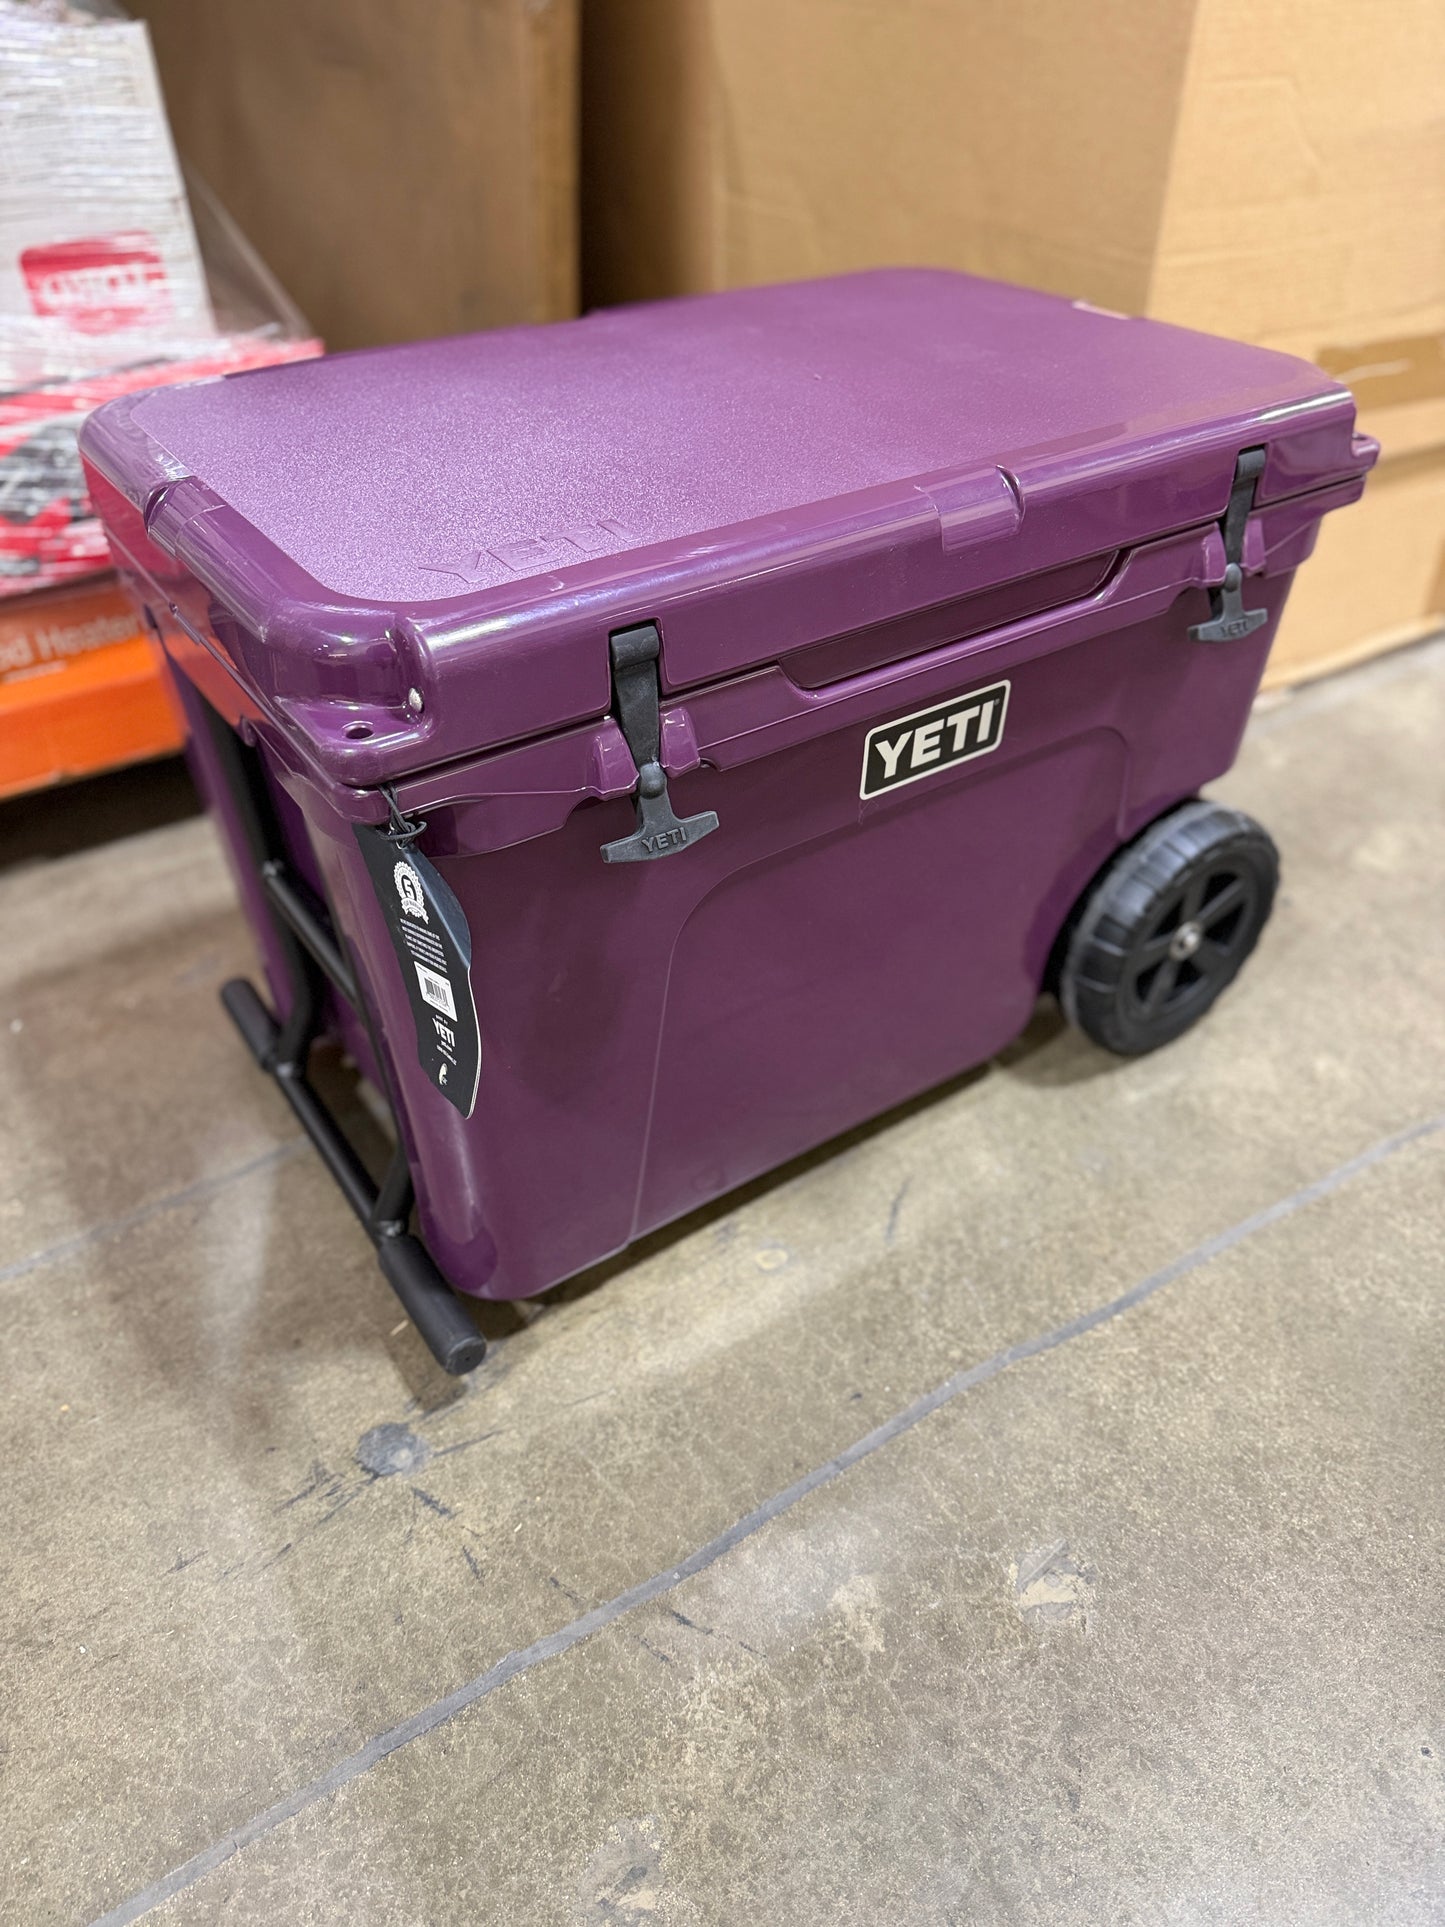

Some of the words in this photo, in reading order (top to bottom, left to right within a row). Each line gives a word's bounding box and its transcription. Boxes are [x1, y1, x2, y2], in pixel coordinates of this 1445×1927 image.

[418, 519, 641, 584] YETI
[34, 615, 139, 660] Heater
[875, 699, 995, 779] YETI
[641, 827, 687, 853] YETI
[403, 878, 415, 898] 5
[432, 1017, 456, 1047] YETI
